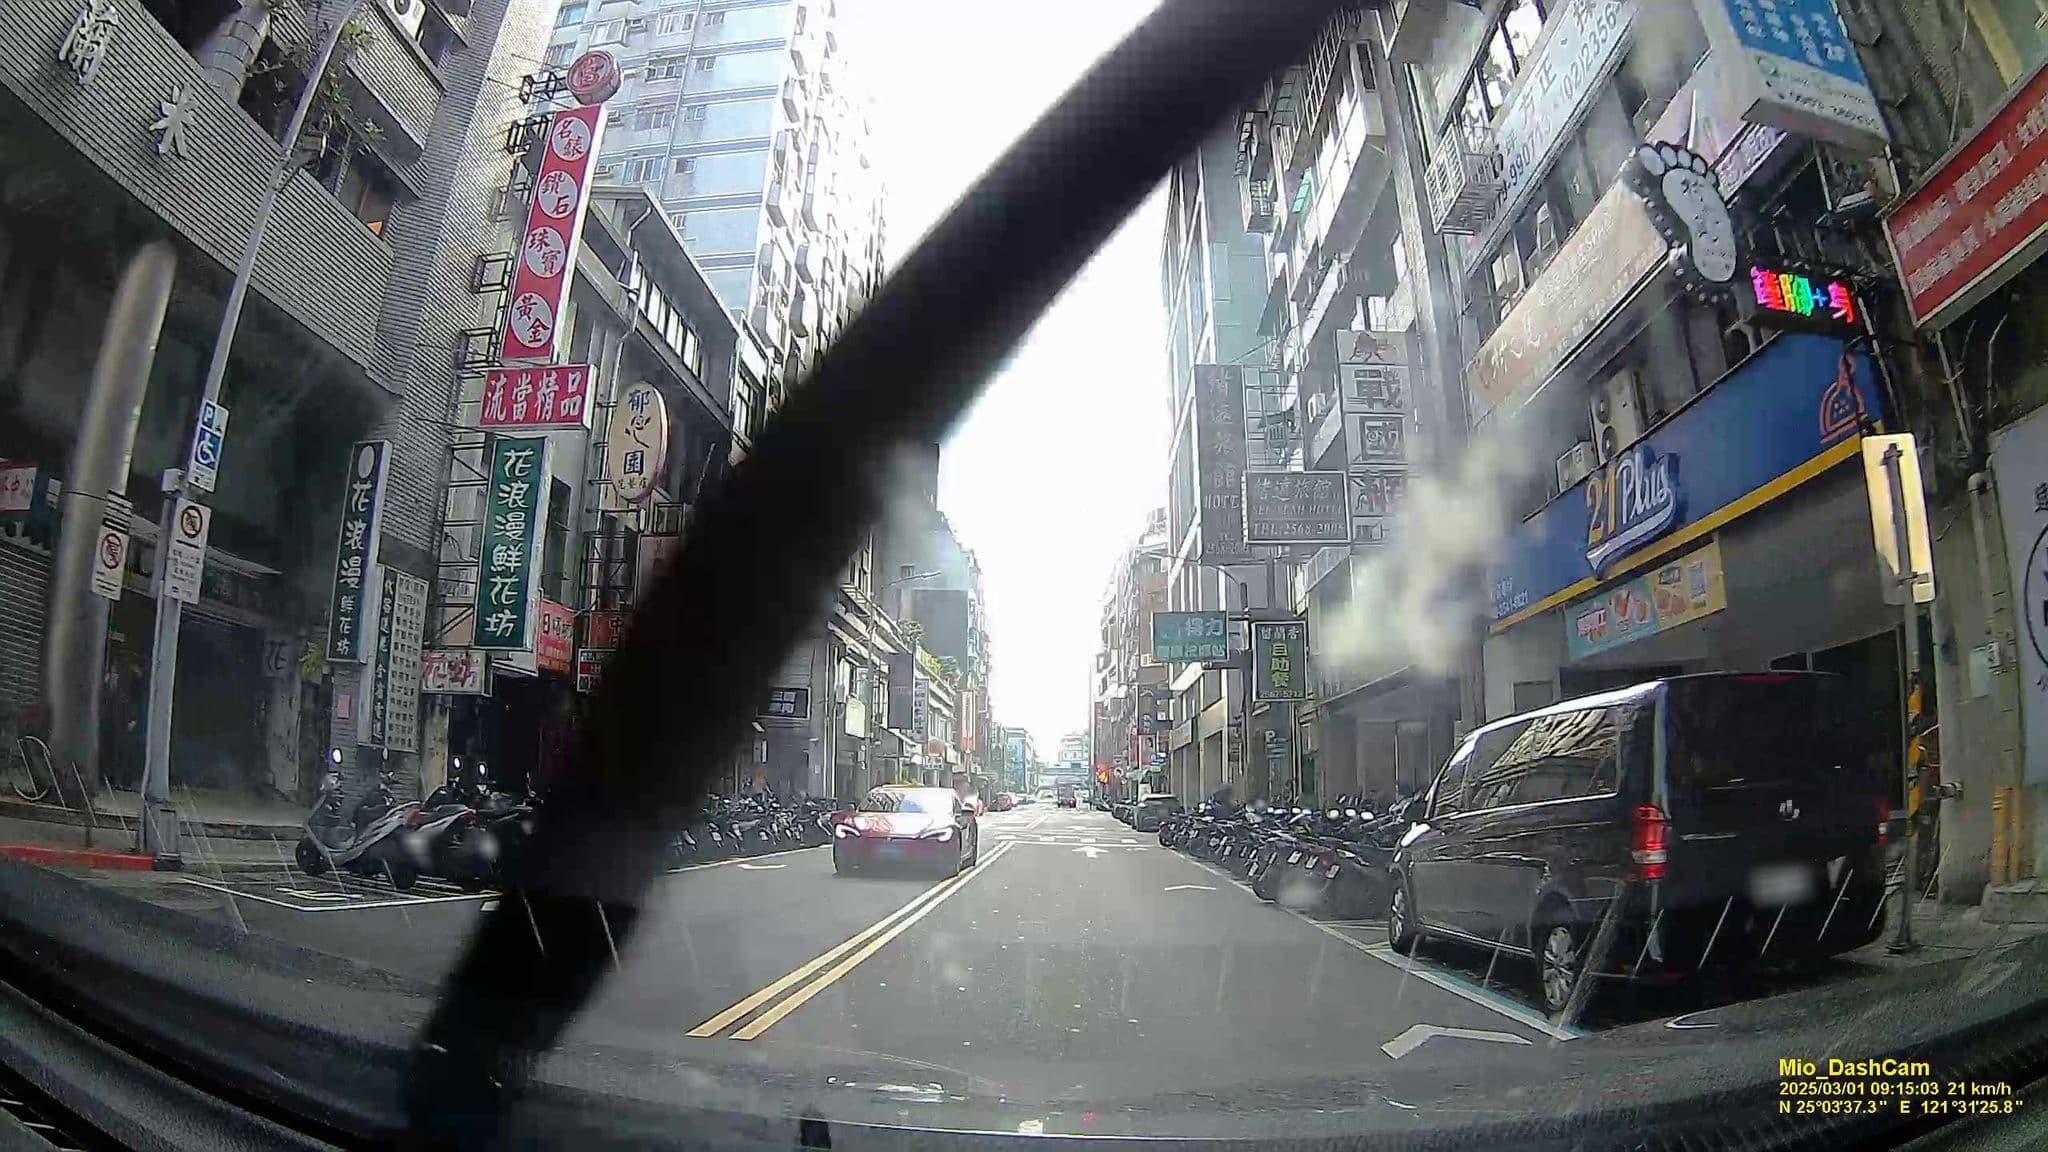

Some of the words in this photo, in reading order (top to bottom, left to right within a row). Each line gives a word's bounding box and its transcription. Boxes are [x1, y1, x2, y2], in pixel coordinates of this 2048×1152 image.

[483, 448, 535, 637] 花浪漫鮮花坊
[1586, 467, 1617, 546] 21
[1616, 450, 1673, 525] Plus
